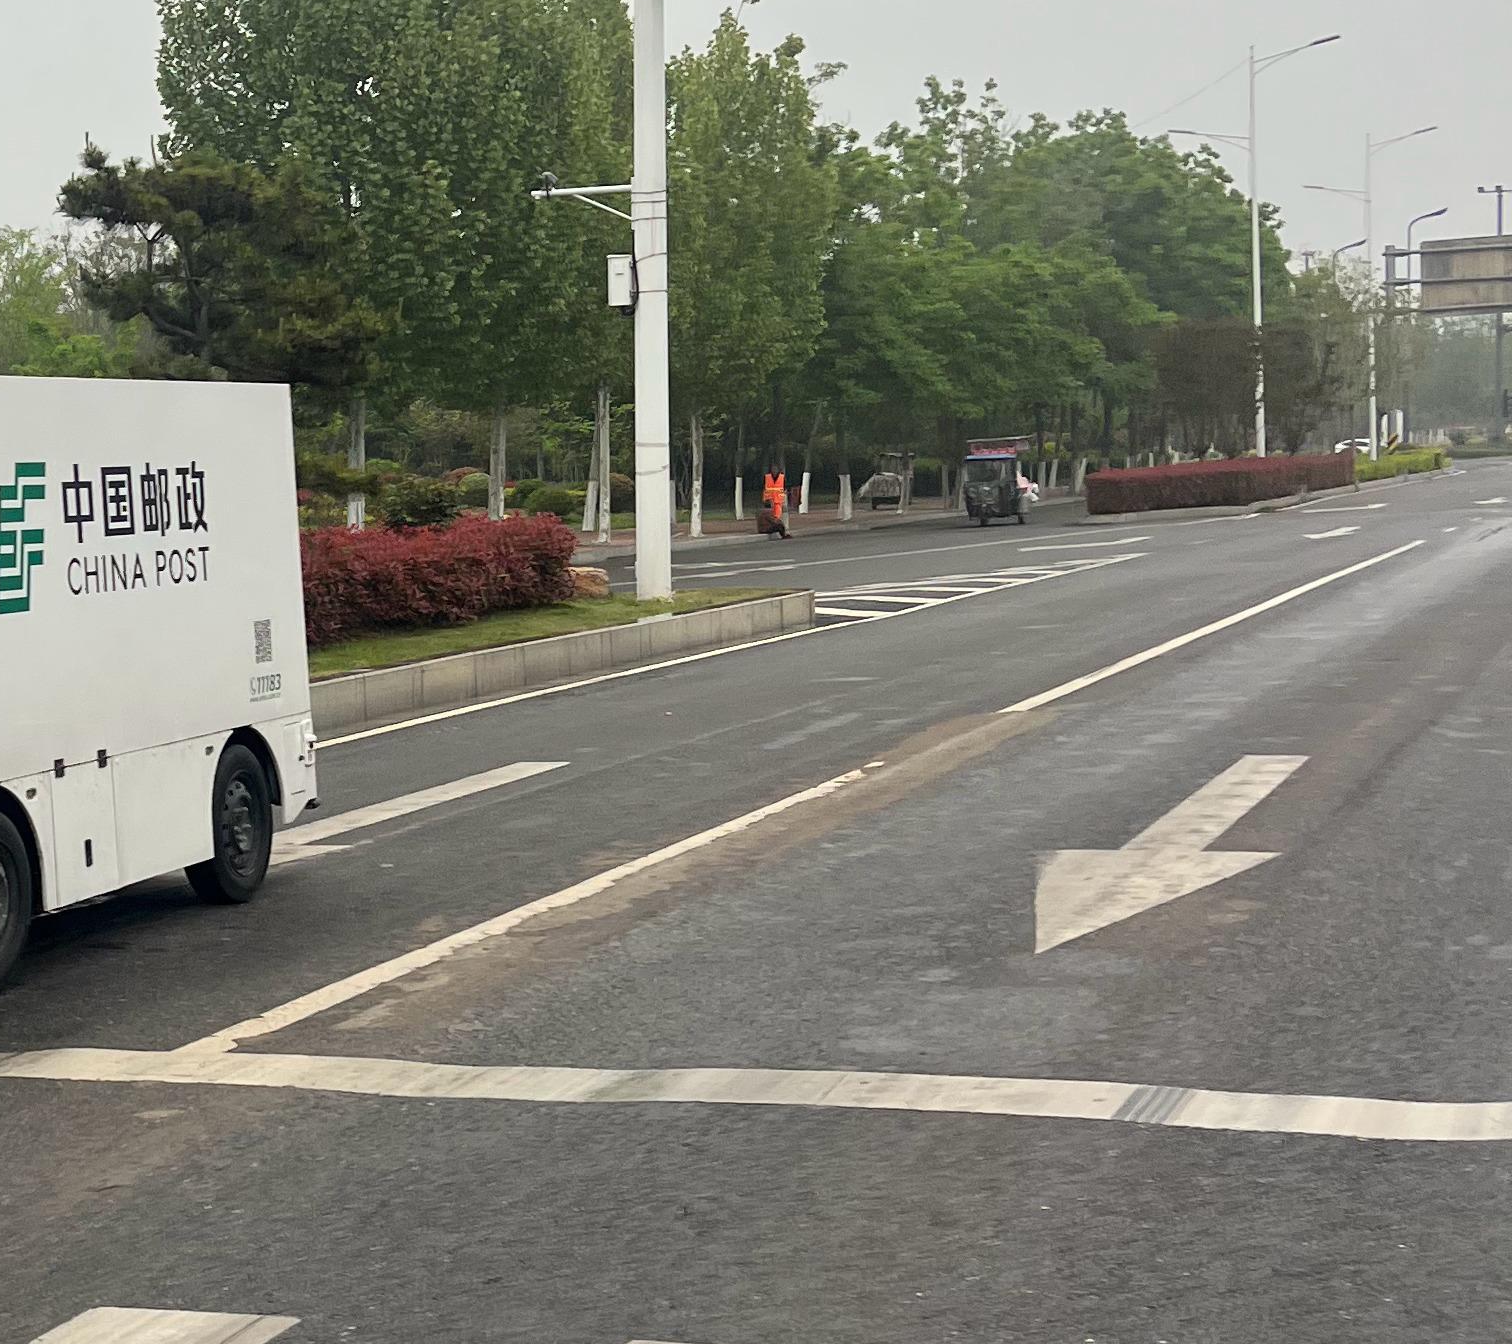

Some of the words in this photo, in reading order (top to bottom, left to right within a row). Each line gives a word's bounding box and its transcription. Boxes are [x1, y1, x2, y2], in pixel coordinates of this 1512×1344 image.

[62, 461, 208, 543] 中国邮政
[67, 553, 147, 595] CHINA
[155, 546, 209, 586] POST
